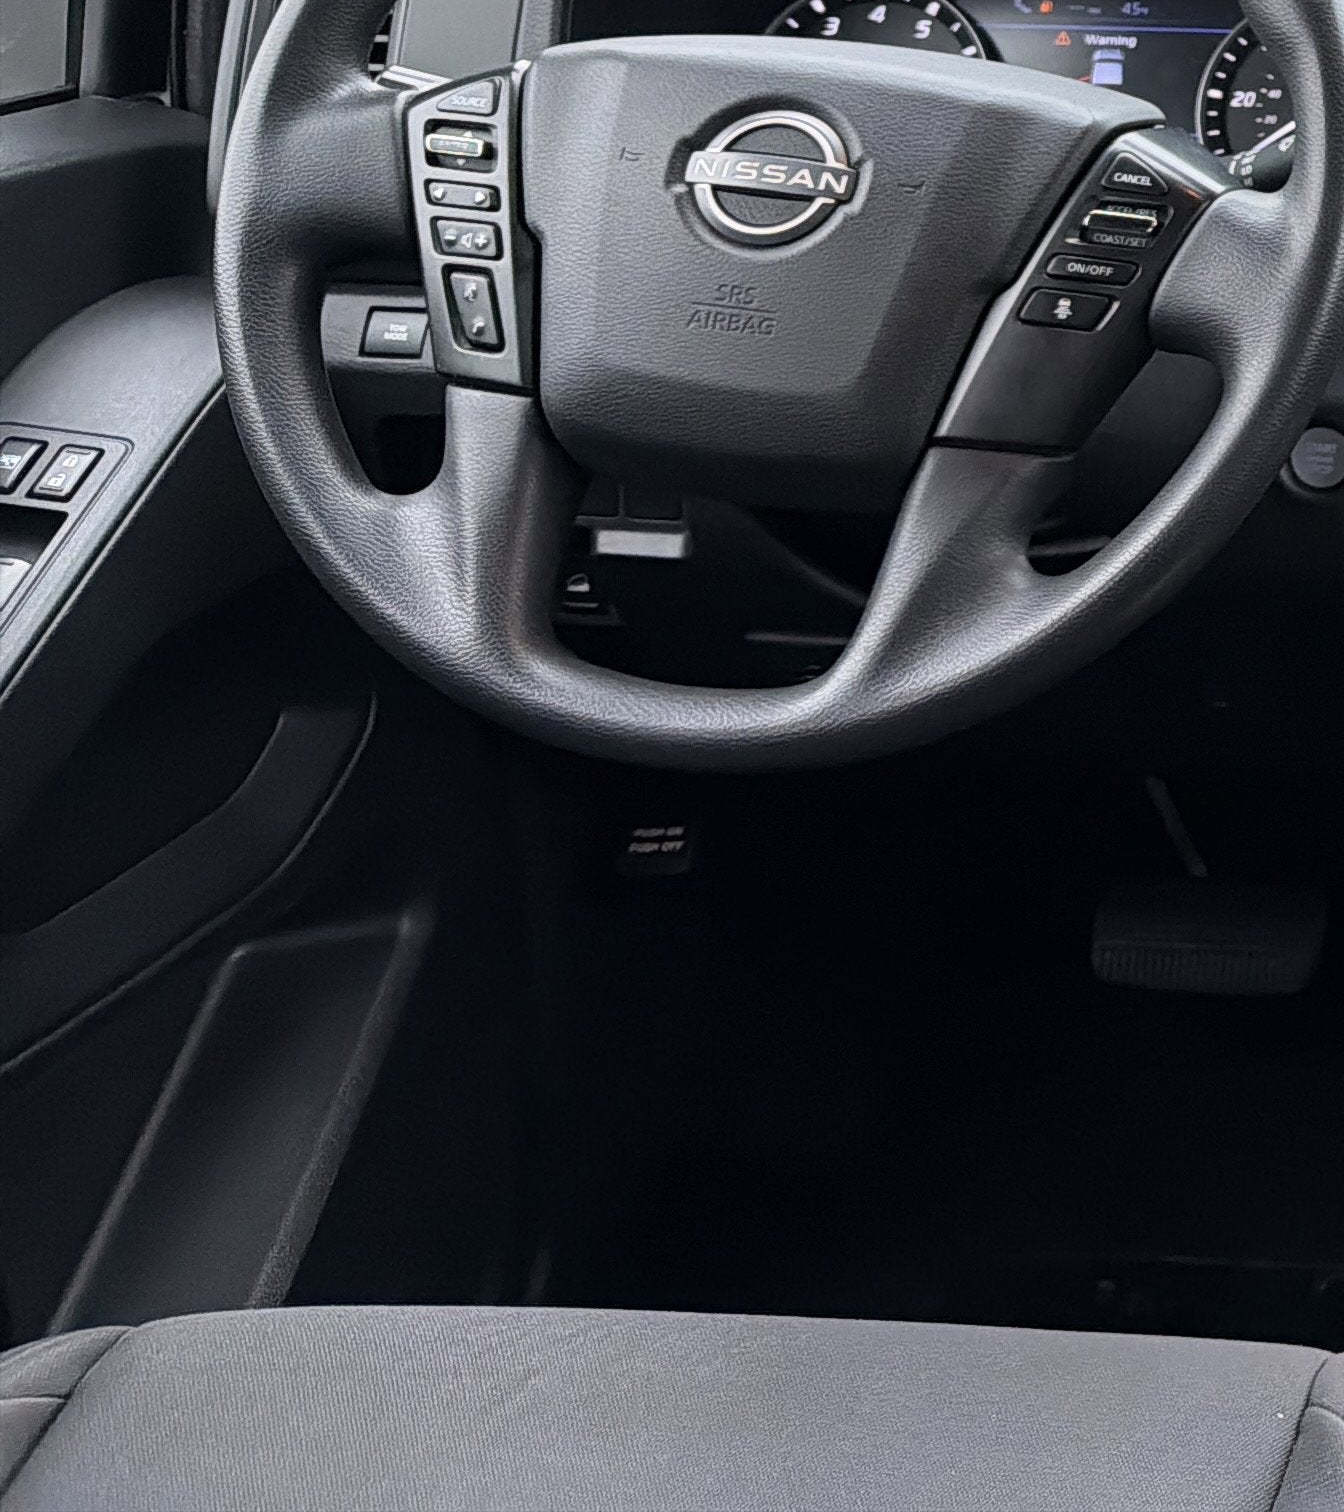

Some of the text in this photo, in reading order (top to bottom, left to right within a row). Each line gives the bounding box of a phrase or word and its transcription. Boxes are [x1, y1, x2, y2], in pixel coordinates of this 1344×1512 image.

[867, 5, 887, 24] 4
[820, 16, 841, 37] 3
[913, 19, 932, 39] 5
[1084, 34, 1138, 49] Warning
[451, 96, 488, 107] SOURCE
[1230, 91, 1256, 107] 20
[693, 159, 849, 194] NISSAN
[1114, 172, 1152, 186] CANCEL
[1094, 233, 1148, 248] COAST/SET
[1067, 263, 1114, 277] ON/OFF
[715, 283, 758, 305] SRS
[687, 309, 778, 336] AIRBAG
